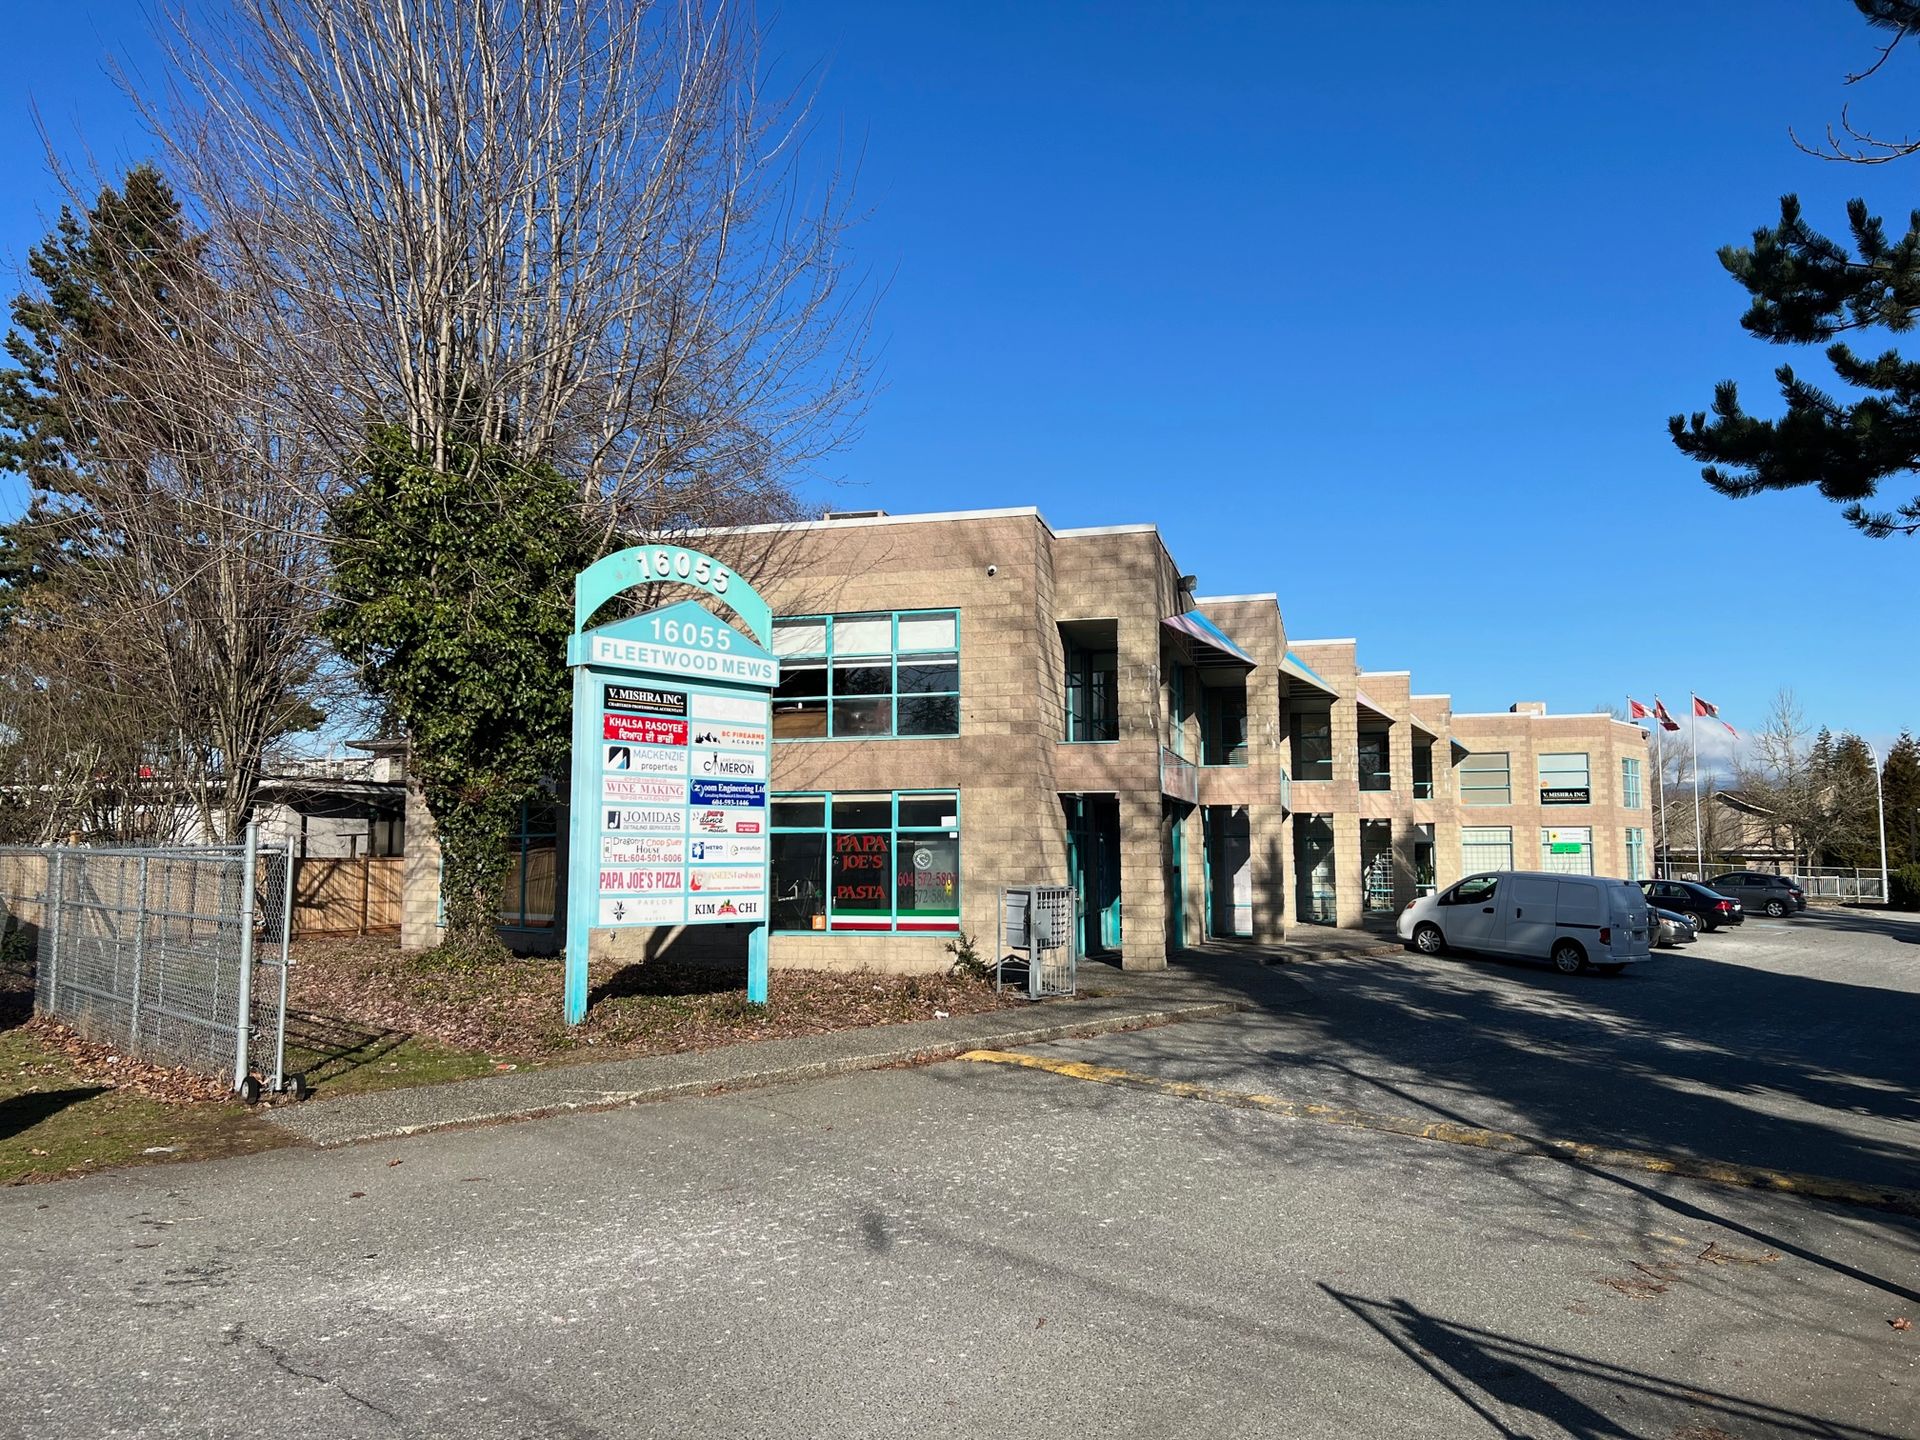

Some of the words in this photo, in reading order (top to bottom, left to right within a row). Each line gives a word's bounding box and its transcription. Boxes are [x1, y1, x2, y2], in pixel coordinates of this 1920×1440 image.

[637, 550, 730, 593] 16055
[651, 617, 731, 650] 16055
[601, 642, 718, 671] FLEETWOOD
[722, 659, 773, 678] MEWS
[608, 688, 618, 698] V.
[619, 689, 661, 703] MISHRA
[663, 693, 684, 705] INC.
[609, 717, 643, 729] KHALSA
[645, 720, 683, 733] RASOYEE
[732, 731, 765, 740] FIREARMS
[633, 749, 685, 761] MACKENZIE
[641, 763, 678, 772] properties
[606, 782, 636, 793] WINE
[641, 784, 684, 795] MAKING
[718, 783, 754, 794] Engineering
[623, 811, 681, 823] JOMIDAS
[700, 812, 724, 823] dance
[646, 839, 665, 847] Chop
[836, 835, 888, 852] PAPA
[842, 854, 883, 871] JOE'S
[600, 872, 624, 889] PAPA
[627, 872, 653, 889] JOE'S
[656, 872, 681, 888] PIZZA
[837, 885, 886, 899] PASTA
[695, 903, 716, 915] KIM
[738, 902, 757, 913] CHI
